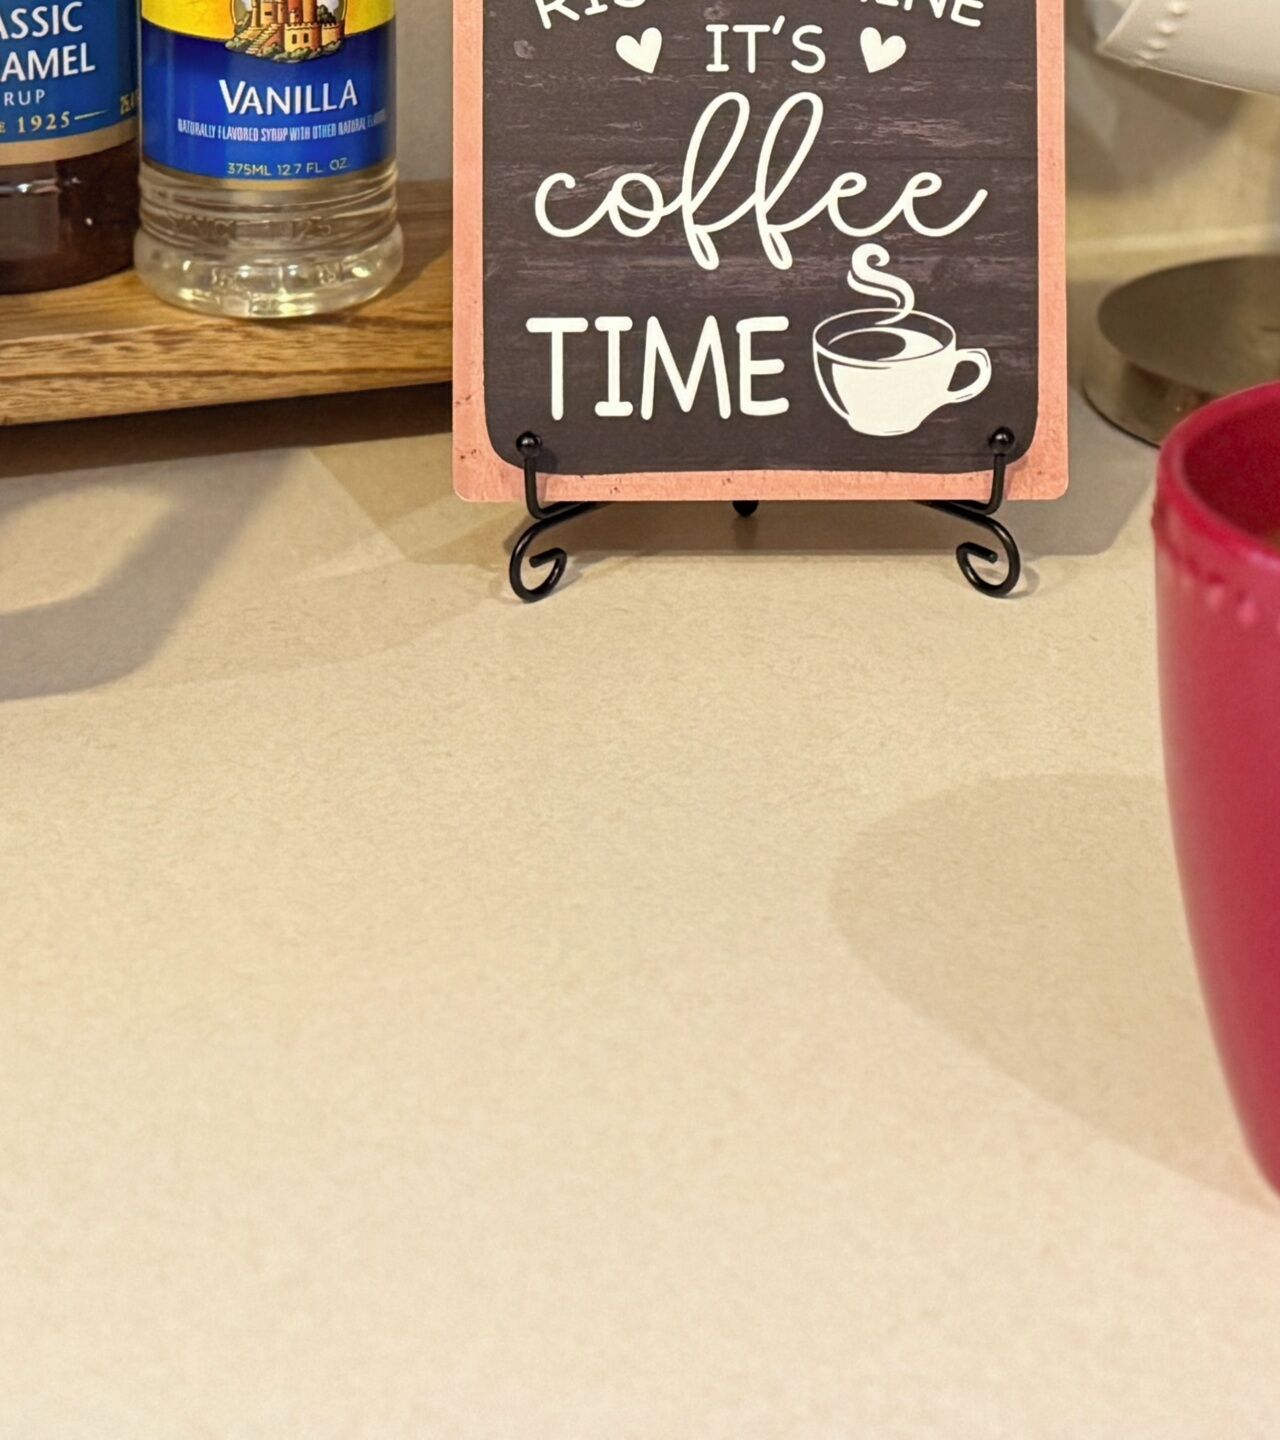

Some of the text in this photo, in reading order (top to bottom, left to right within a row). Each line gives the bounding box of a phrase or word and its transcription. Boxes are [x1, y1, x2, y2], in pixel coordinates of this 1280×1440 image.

[704, 15, 827, 74] IT'S
[218, 79, 359, 115] VANILLA
[18, 111, 71, 134] 1925
[218, 125, 259, 142] FLAVORED
[261, 126, 289, 142] SYRUP
[289, 126, 311, 142] WITH
[312, 122, 337, 140] OTHER
[227, 162, 272, 177] 375ML
[534, 91, 989, 271] coffee
[525, 315, 790, 421] TIME
